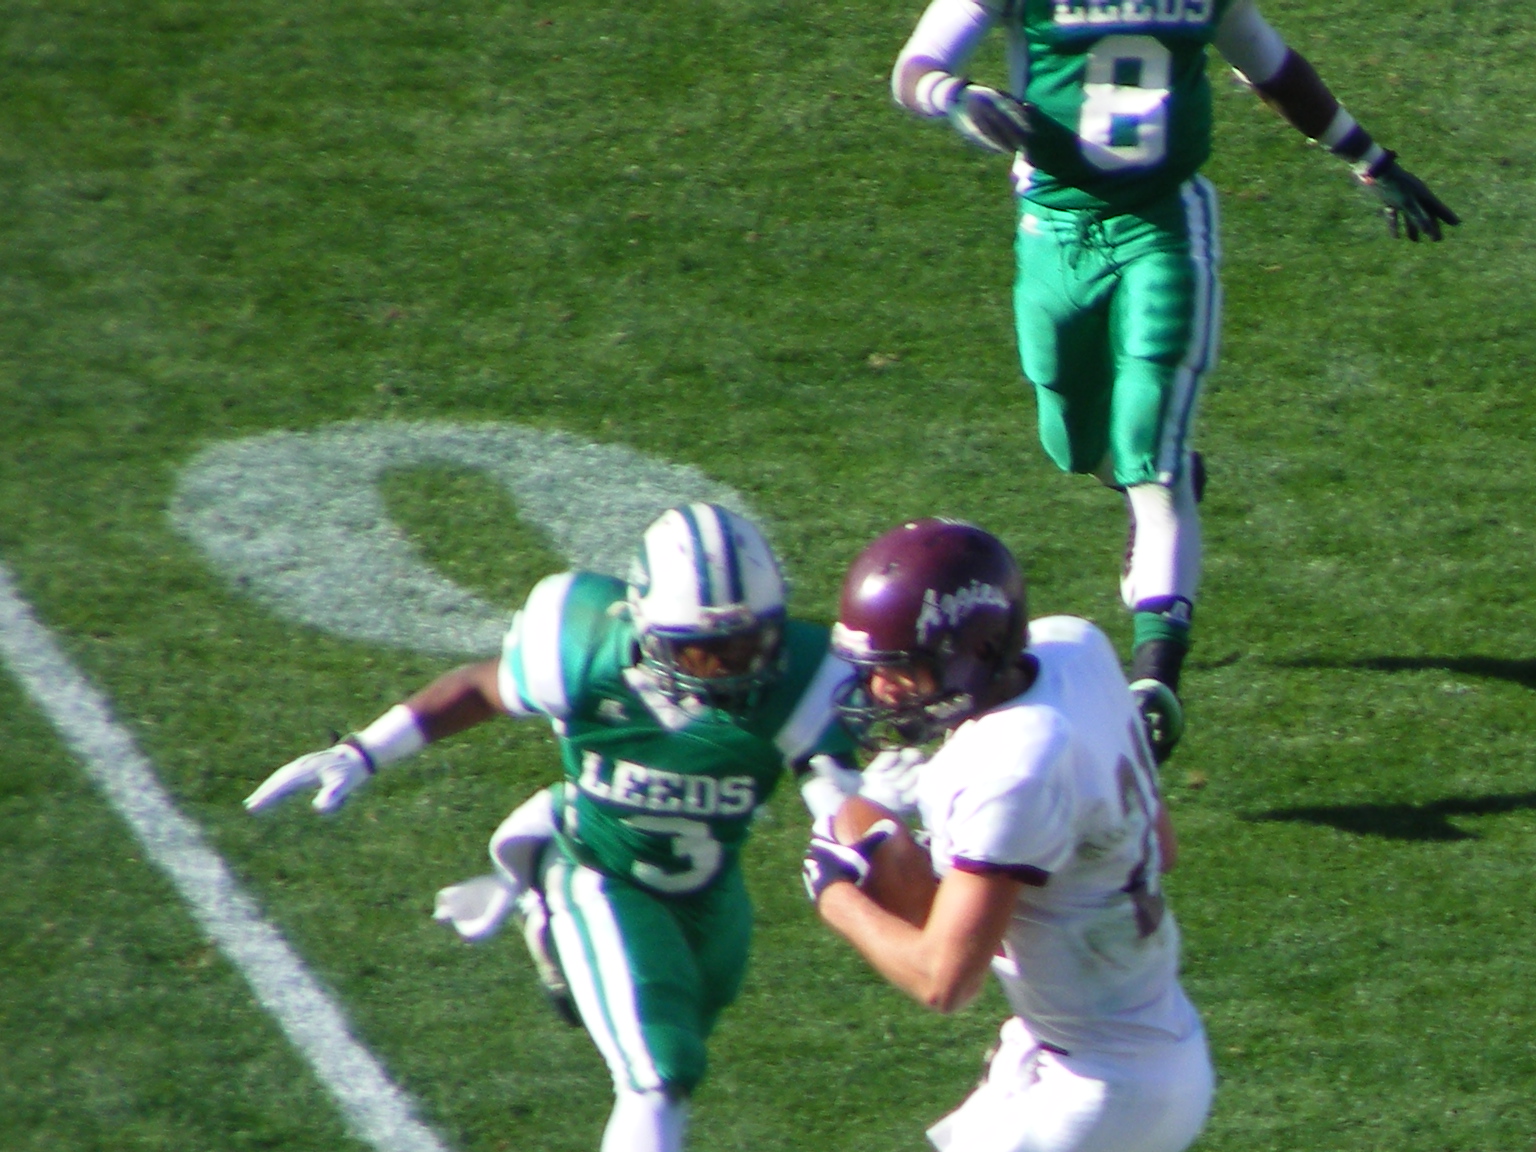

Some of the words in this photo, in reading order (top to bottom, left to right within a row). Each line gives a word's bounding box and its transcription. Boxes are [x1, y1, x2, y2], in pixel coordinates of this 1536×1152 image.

[1079, 34, 1170, 171] 8
[578, 750, 756, 817] LEEDS
[627, 815, 721, 895] 3
